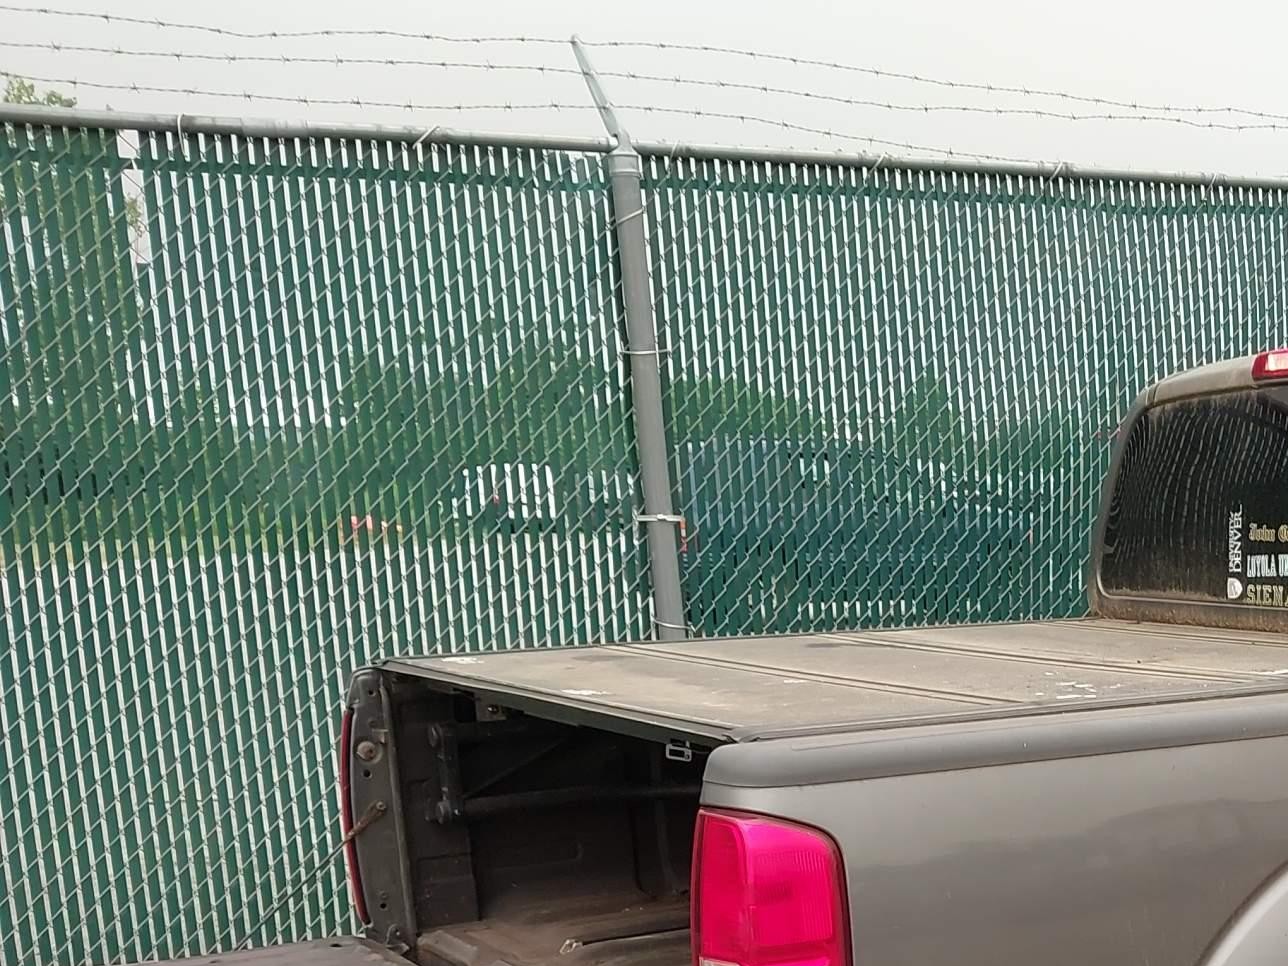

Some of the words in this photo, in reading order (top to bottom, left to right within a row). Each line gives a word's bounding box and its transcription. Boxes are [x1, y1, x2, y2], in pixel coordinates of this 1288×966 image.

[1234, 504, 1243, 573] DENVER
[1248, 522, 1276, 543] John
[1246, 554, 1277, 579] LOYOLA
